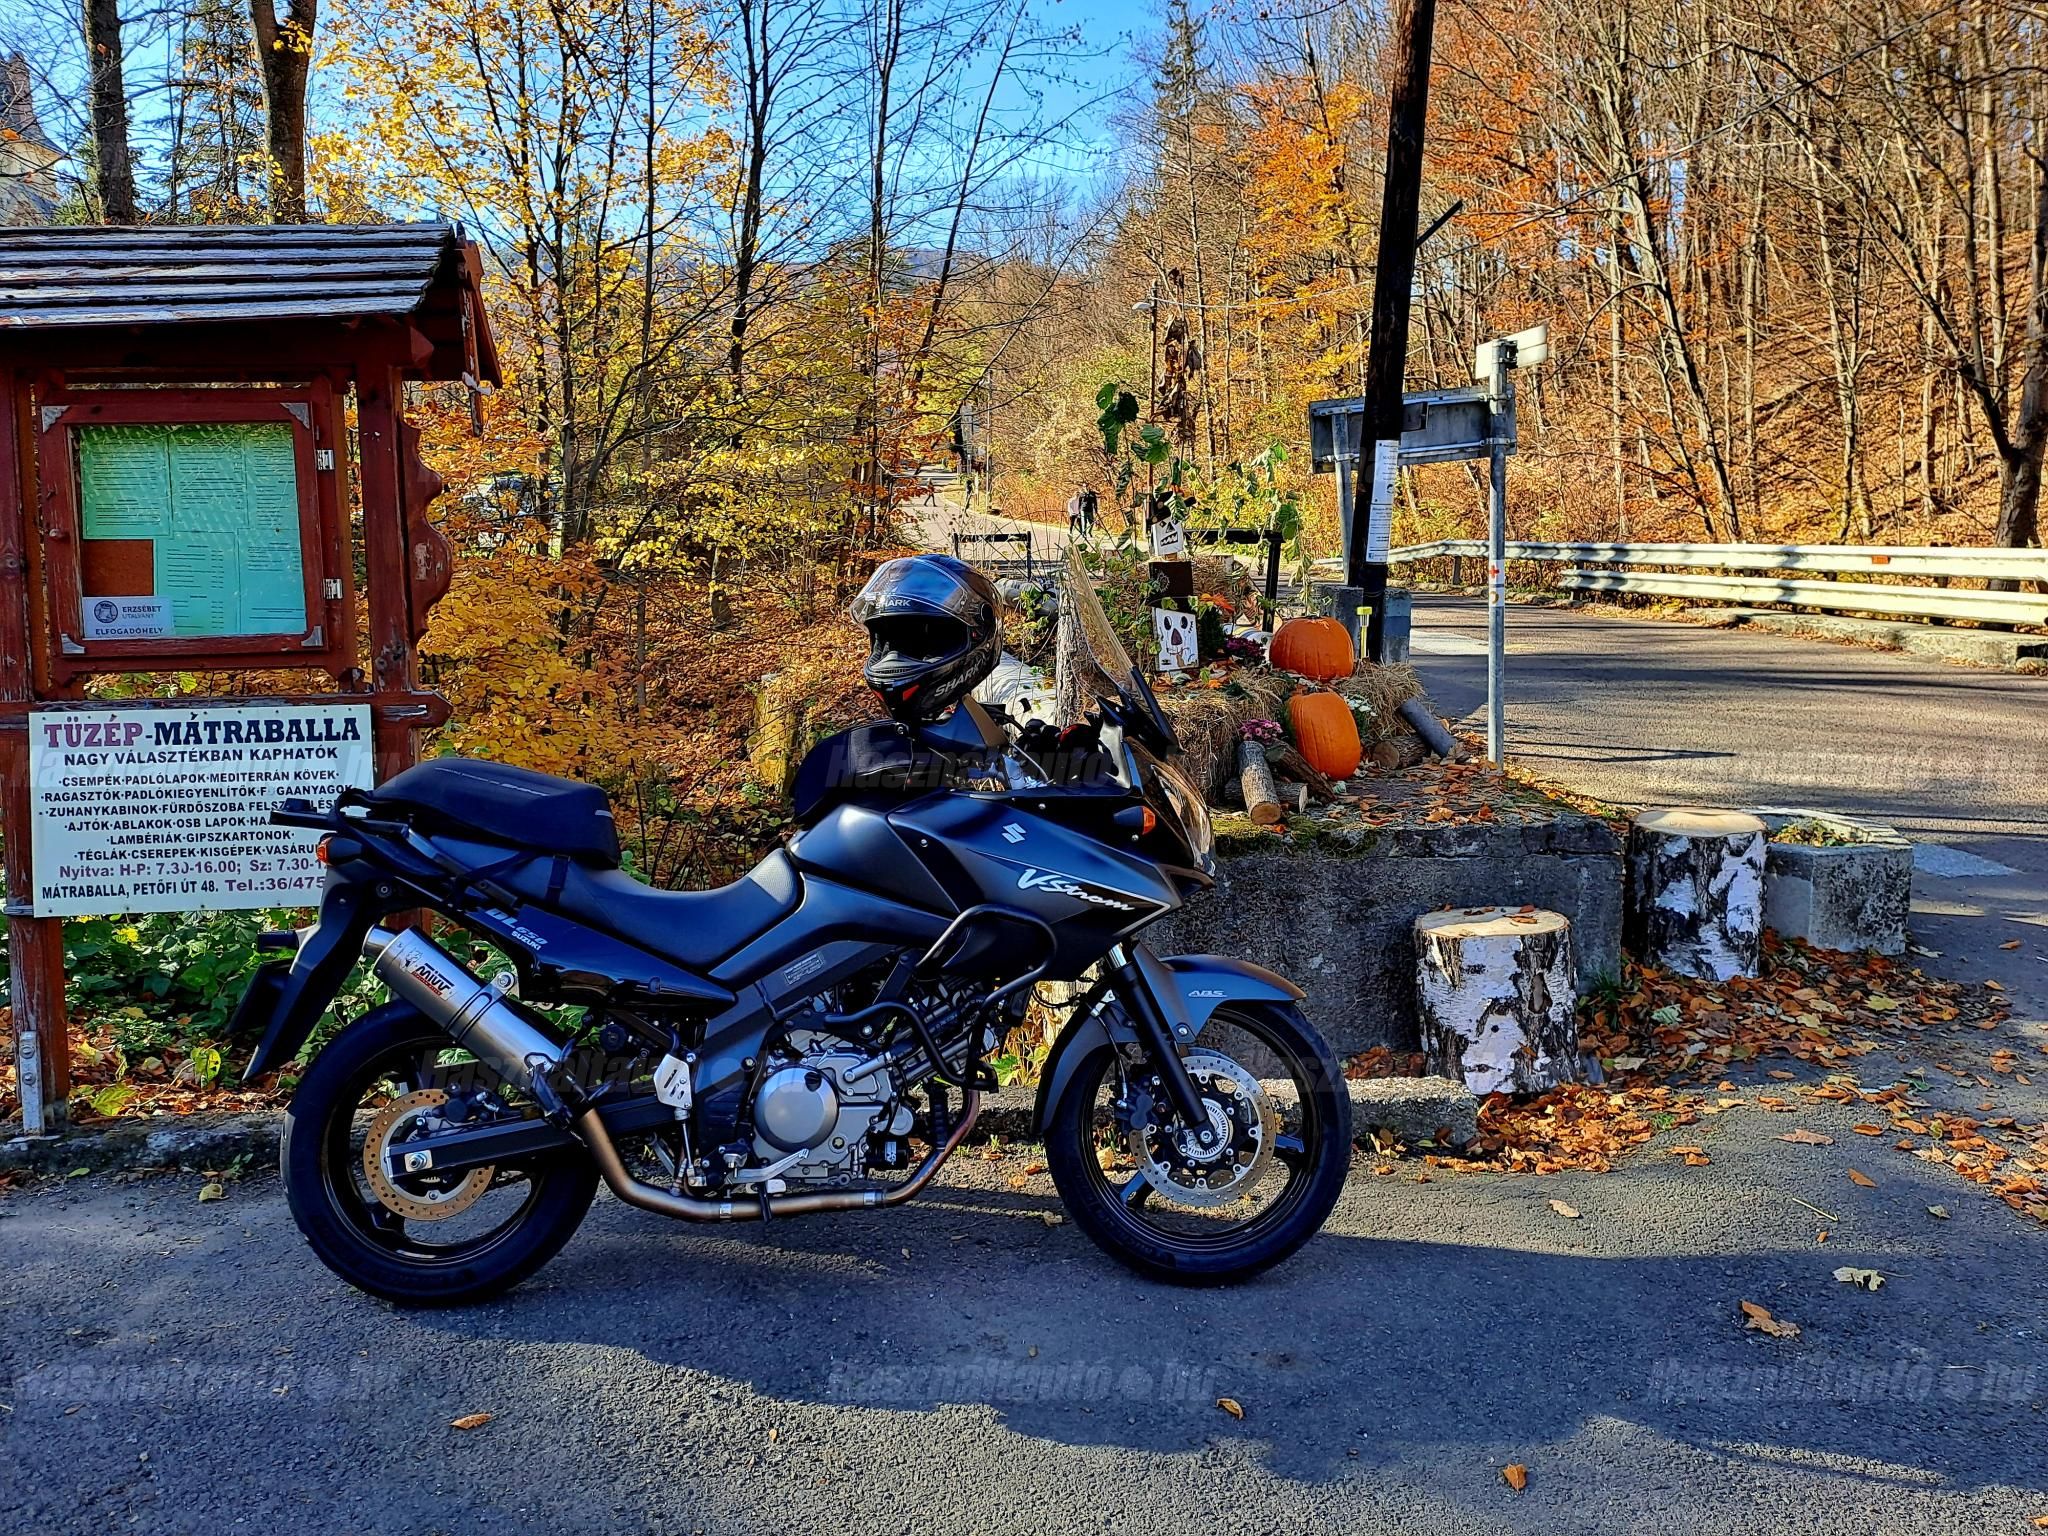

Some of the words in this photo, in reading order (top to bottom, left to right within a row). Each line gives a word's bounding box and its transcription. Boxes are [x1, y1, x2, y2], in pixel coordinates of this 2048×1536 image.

[64, 753, 109, 766] NAGY
[115, 748, 243, 764] VÁLASZTÉKBAN
[250, 745, 338, 761] KAPHATÓK
[59, 865, 114, 880] Nyitva:
[120, 863, 151, 876] H-P:
[250, 860, 272, 872] Sz:
[42, 883, 130, 899] MÁTRABALLA,
[133, 879, 177, 895] PETŐFI
[180, 877, 197, 892] ÚT
[201, 880, 219, 892] 48.
[511, 930, 542, 951] SUZUKI
